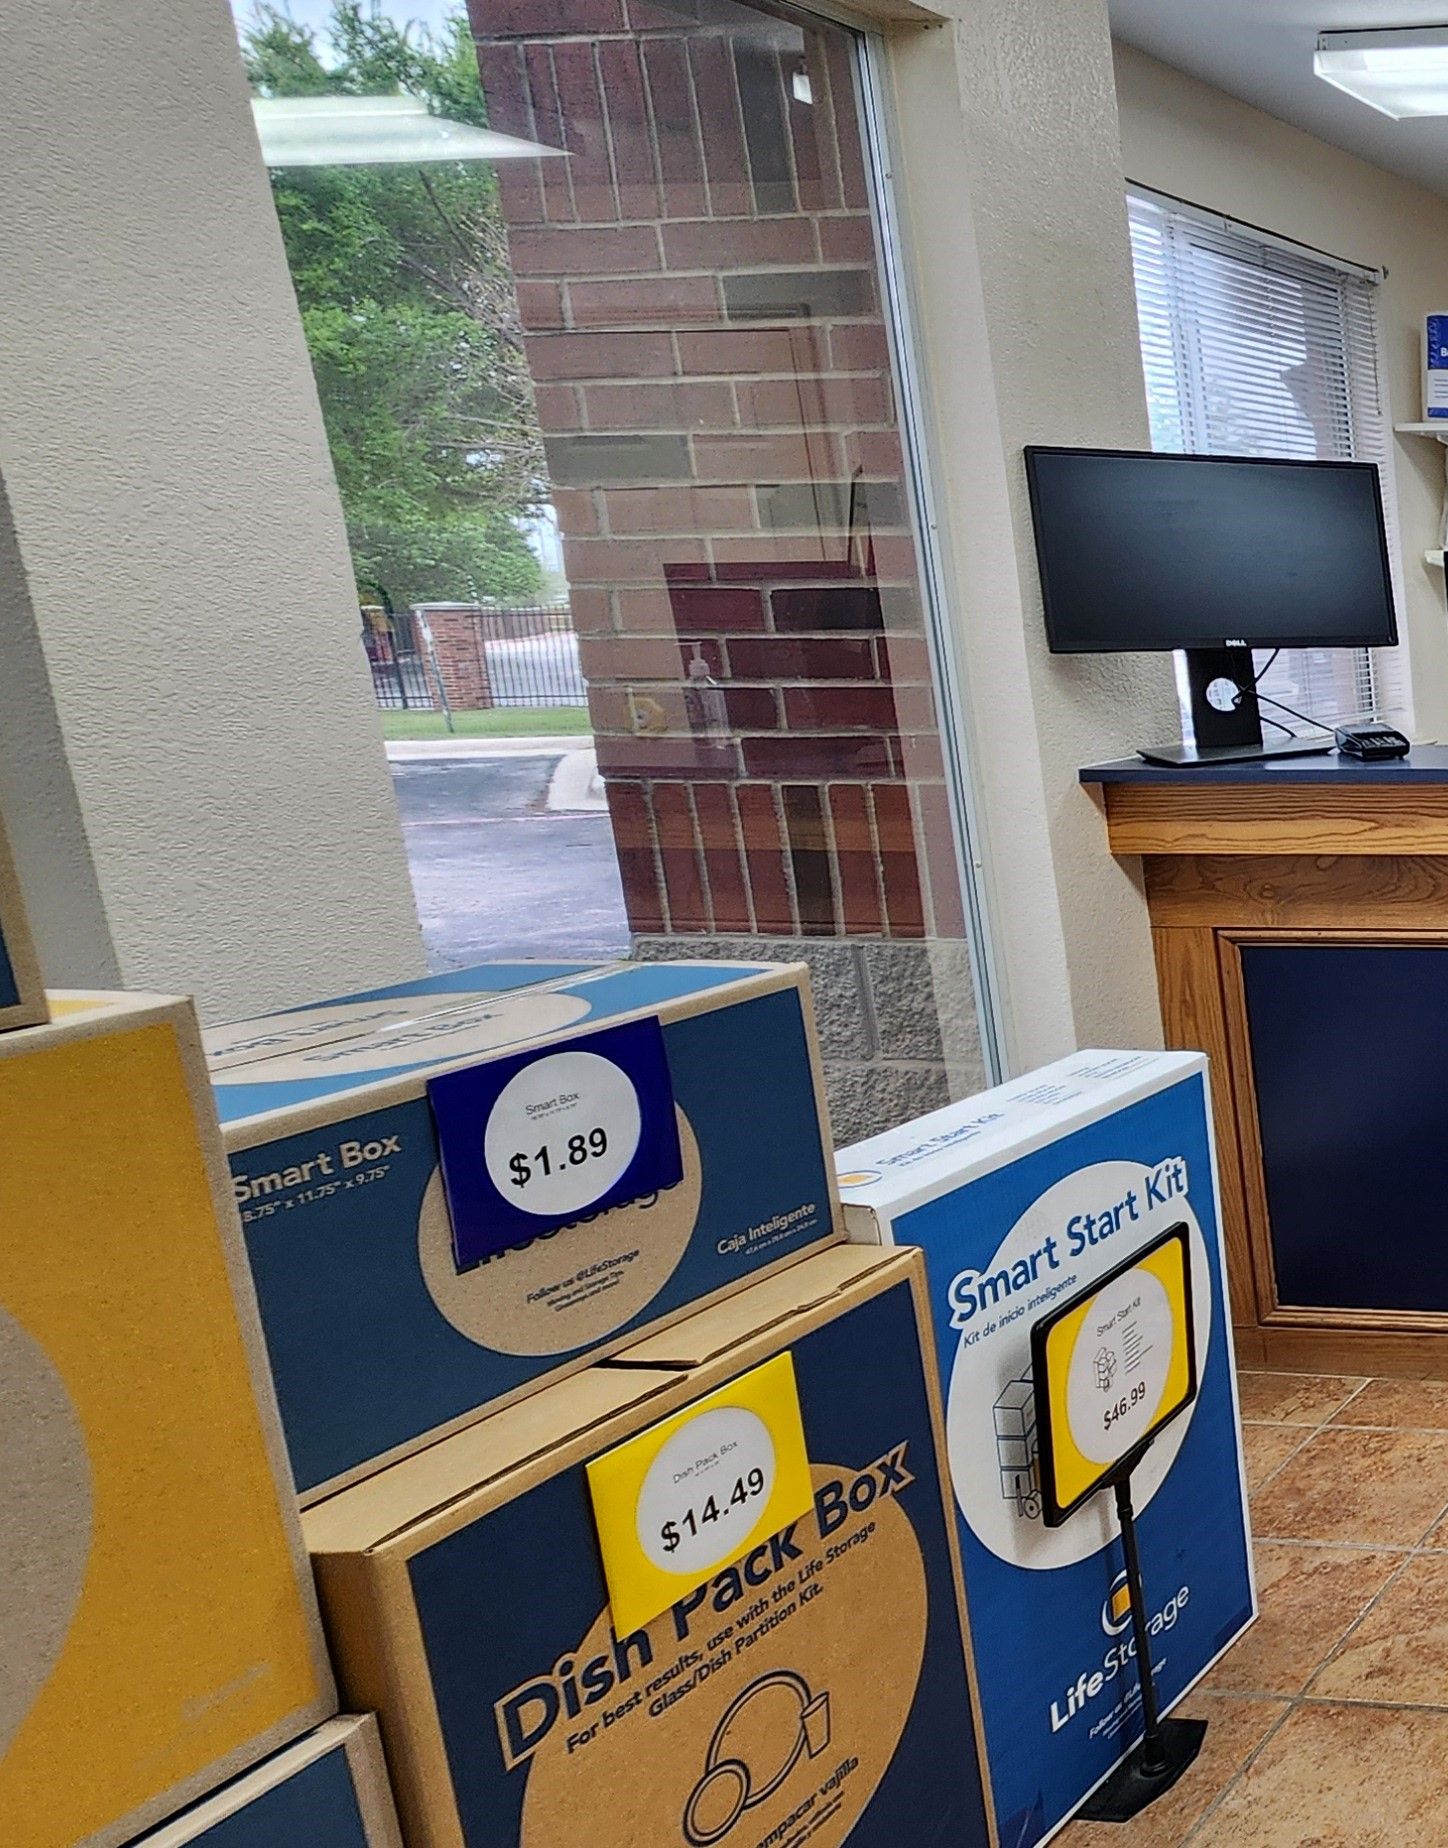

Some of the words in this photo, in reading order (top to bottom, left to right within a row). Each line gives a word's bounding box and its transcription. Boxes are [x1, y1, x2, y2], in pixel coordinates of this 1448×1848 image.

[1226, 640, 1247, 648] DELL
[525, 1099, 557, 1115] Smart
[560, 1092, 580, 1105] Box
[232, 1152, 335, 1200] Smart
[339, 1135, 402, 1169] Box
[509, 1127, 608, 1188] $1.89
[717, 1234, 747, 1254] Caja
[748, 1203, 816, 1241] Inteligente
[953, 1236, 1060, 1322] Smart
[1066, 1190, 1139, 1257] Start
[1144, 1163, 1184, 1211] Kit
[527, 1284, 560, 1304] Follow
[562, 1277, 575, 1288] us
[576, 1249, 640, 1282] @LifeStorage
[963, 1330, 980, 1348] Kit
[983, 1322, 997, 1337] de
[999, 1306, 1025, 1329] inicio
[1027, 1274, 1077, 1311] inteligente
[1097, 1315, 1117, 1337] Smart
[1117, 1304, 1132, 1322] Start
[1132, 1297, 1141, 1310] Kit
[1103, 1381, 1146, 1431] $46.99
[672, 1464, 694, 1484] Dish
[695, 1452, 719, 1470] Pack
[720, 1441, 738, 1455] Box
[660, 1467, 765, 1554] $14.49
[502, 1626, 654, 1759] Dish
[670, 1521, 804, 1641] Pack
[814, 1448, 910, 1539] Box
[566, 1722, 599, 1754] For
[602, 1691, 643, 1729] best
[645, 1650, 703, 1697] results,
[706, 1626, 734, 1650] use
[736, 1600, 769, 1629] with
[771, 1580, 796, 1602] the
[798, 1559, 824, 1584] Life
[825, 1522, 876, 1564] Storage
[649, 1649, 733, 1717] Glass/Dish
[734, 1601, 797, 1654] Partition
[819, 1757, 859, 1796] vajilla
